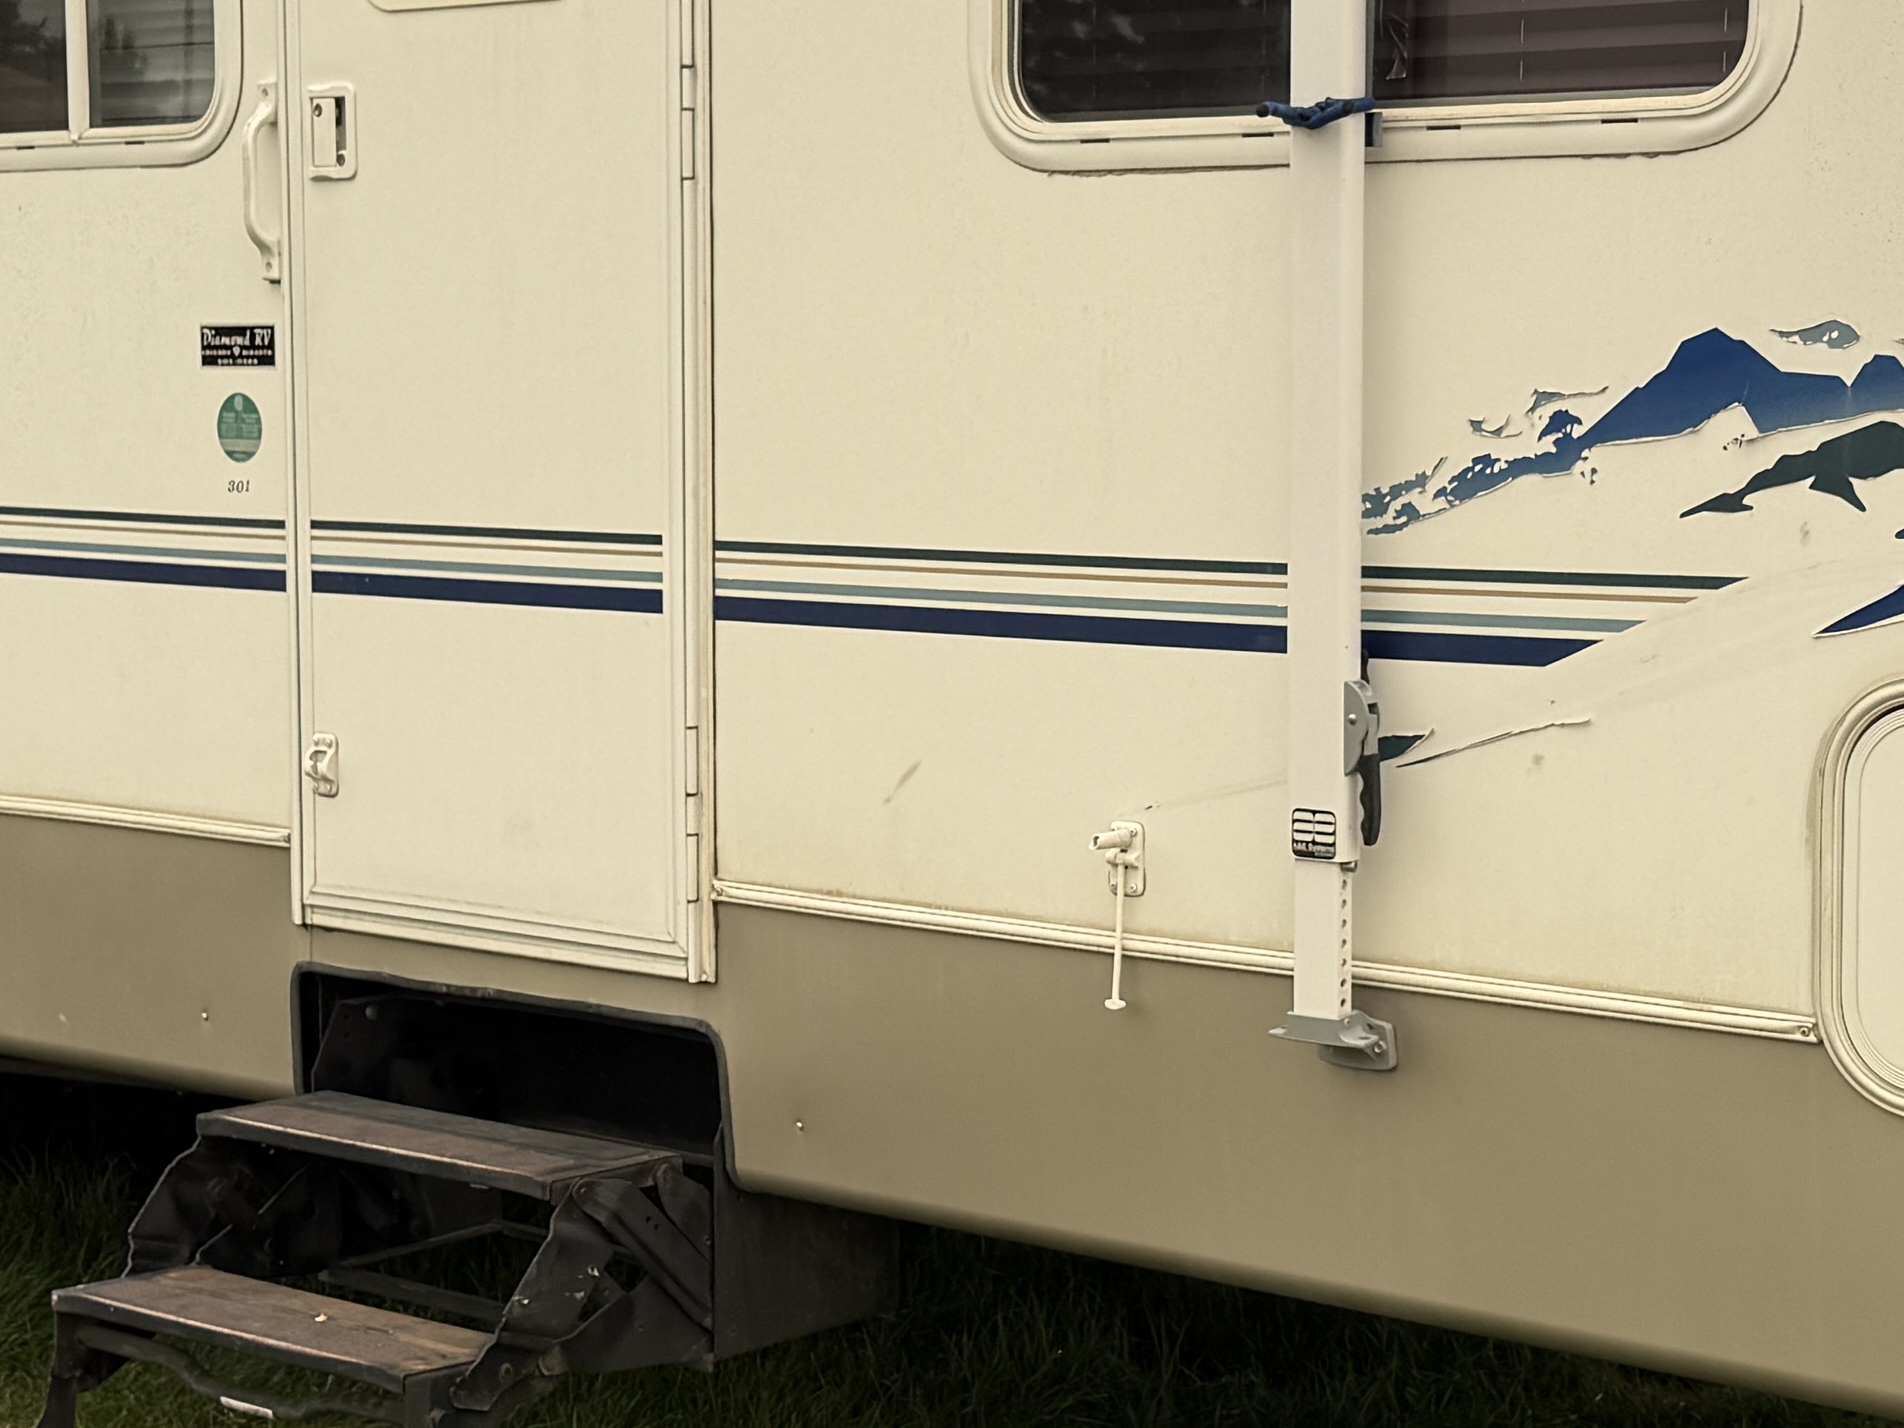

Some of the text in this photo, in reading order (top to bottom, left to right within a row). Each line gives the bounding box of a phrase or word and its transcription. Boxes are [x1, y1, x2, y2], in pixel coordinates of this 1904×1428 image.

[202, 328, 272, 346] Diamond RV
[227, 479, 250, 493] 301
